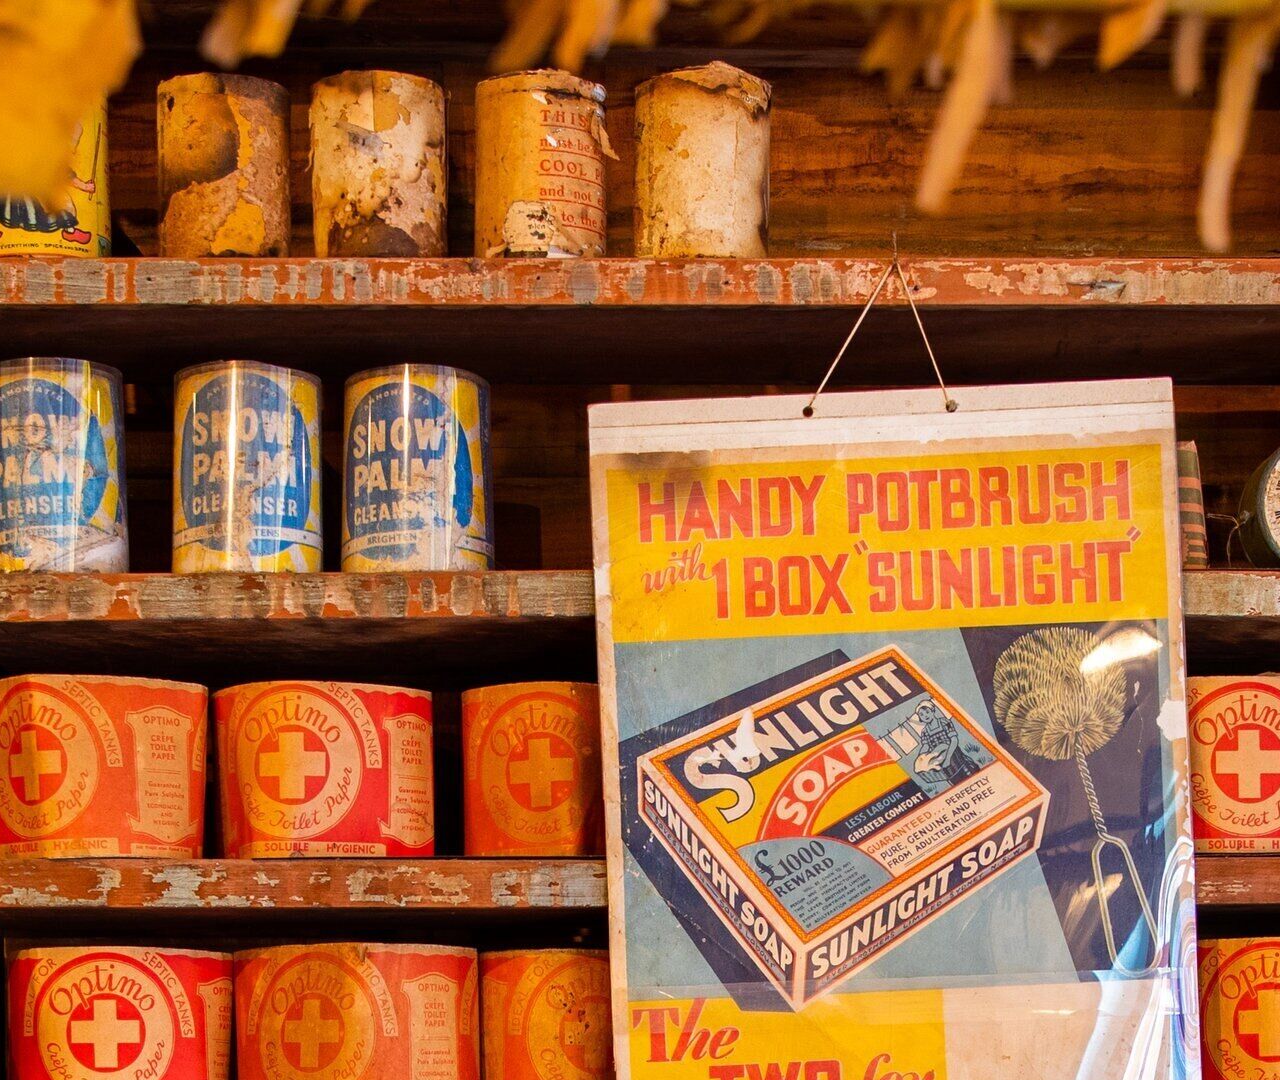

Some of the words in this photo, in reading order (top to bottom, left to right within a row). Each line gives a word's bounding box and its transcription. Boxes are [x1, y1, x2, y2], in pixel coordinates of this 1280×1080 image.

[540, 109, 588, 127] THIS
[540, 159, 587, 177] COOL
[540, 185, 565, 197] and
[574, 188, 592, 201] not
[581, 215, 598, 227] the
[192, 407, 296, 447] SNOW
[353, 417, 451, 459] SNOW
[192, 451, 297, 486] PALM
[638, 475, 826, 543] HANDY
[846, 460, 1131, 535] POTBRUSH
[640, 542, 714, 594] with
[710, 557, 730, 619] 1
[743, 551, 854, 619] BOX
[854, 526, 1143, 612] "SUNLIGHT"
[142, 714, 181, 728] OPTIMO
[244, 695, 341, 744] Optimo
[327, 682, 364, 718] SEPTIC
[360, 718, 381, 767] TANKS
[684, 662, 911, 824] SUNLIGHT
[776, 738, 869, 826] SOAP
[945, 776, 991, 806] PERFECTLY
[845, 811, 868, 830] LESS
[868, 791, 904, 818] LABOUR
[848, 817, 884, 843] GREATER
[884, 792, 924, 821] COMFORT
[880, 842, 908, 861] PURE,
[906, 815, 950, 844] GENUINE
[951, 801, 970, 818] AND
[972, 786, 996, 806] FREE
[1219, 808, 1271, 828] Toilet
[754, 840, 827, 887] £1000
[887, 852, 913, 869] FROM
[1208, 840, 1256, 850] SOLUBLE
[643, 780, 741, 910] SUNLIGHT
[740, 901, 793, 972] SOAP
[774, 857, 835, 899] REWARD
[811, 864, 954, 979] SUNLIGHT
[962, 816, 1034, 879] SOAP
[48, 964, 155, 1016] Optimo
[142, 951, 177, 989] SEPTIC
[173, 990, 194, 1036] TANKS
[633, 997, 741, 1064] The
